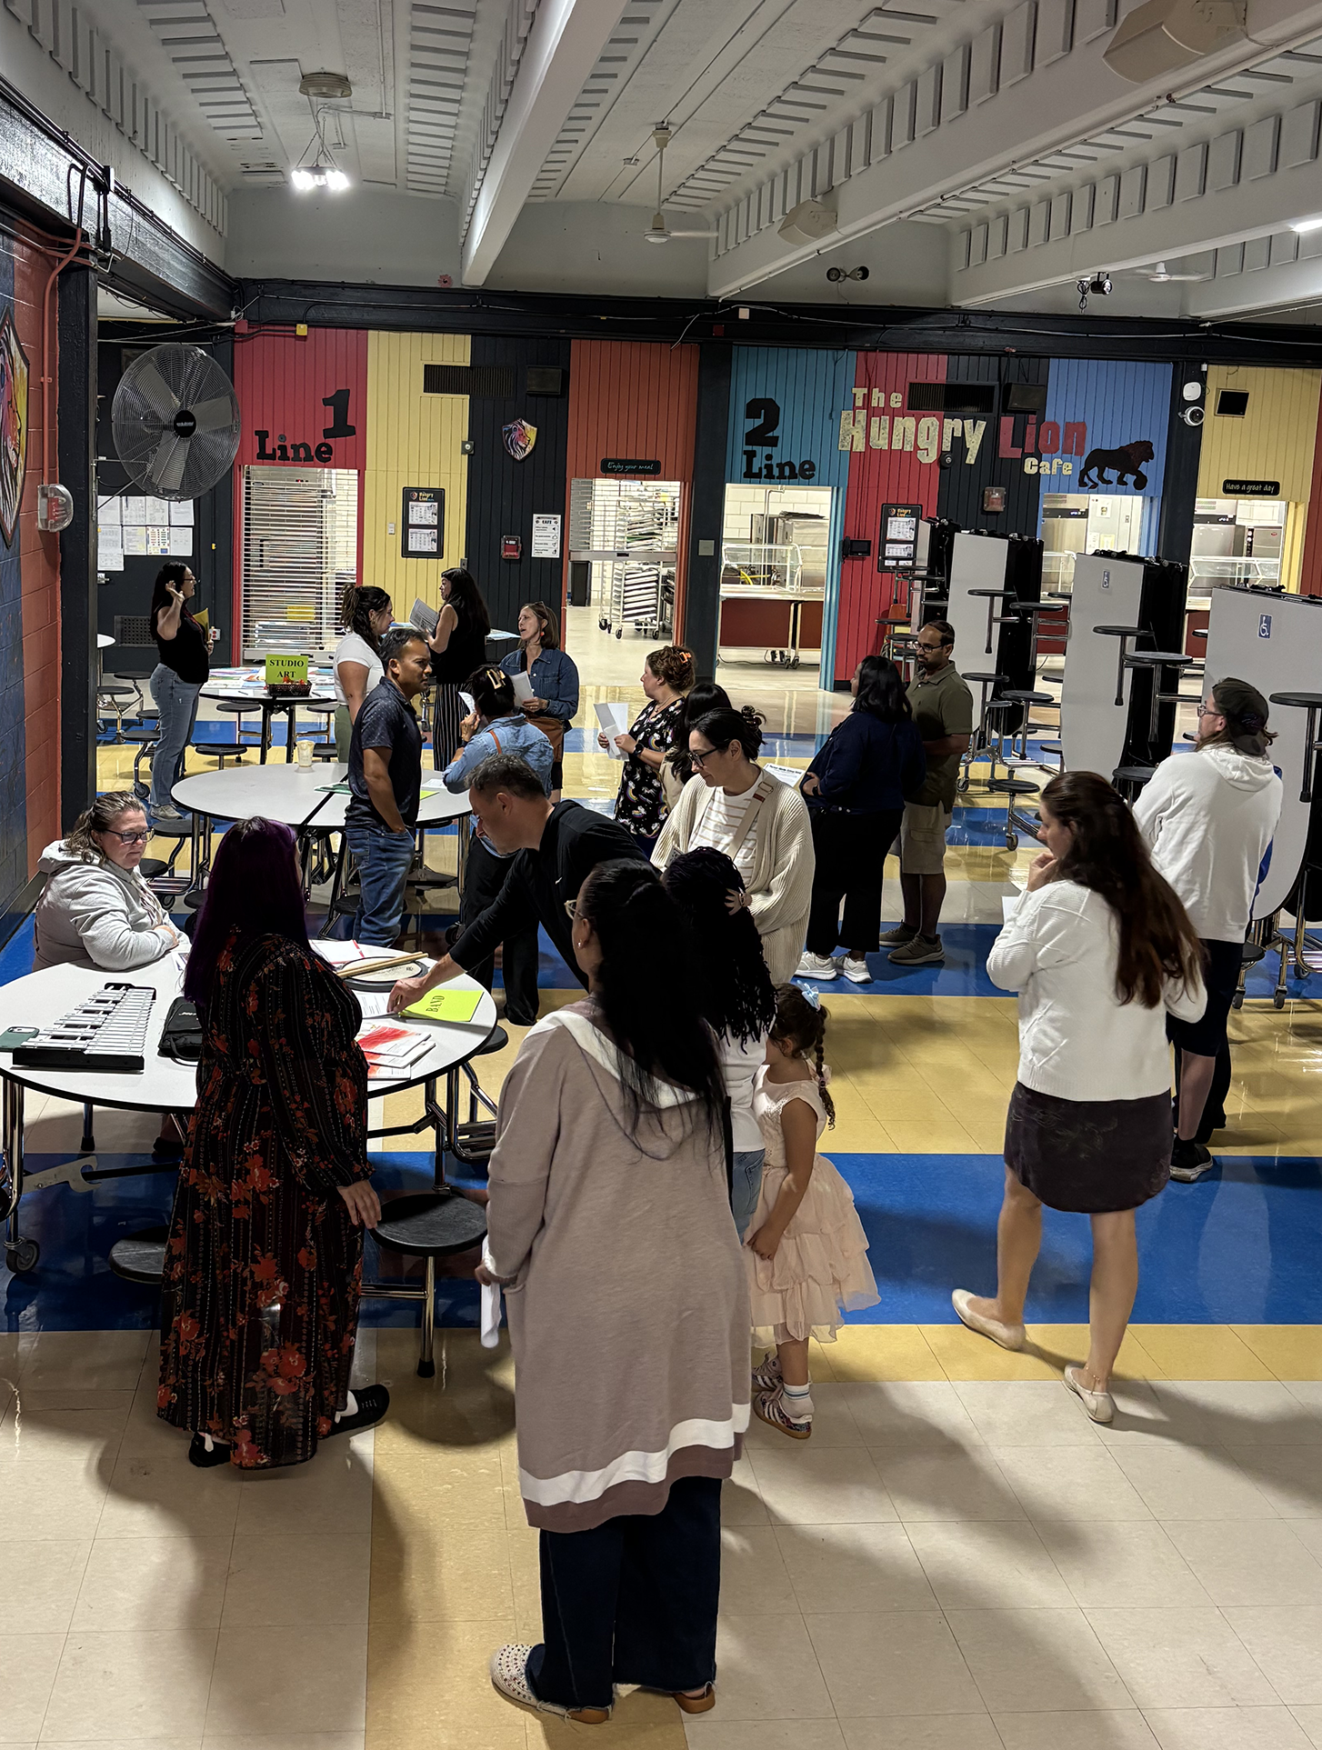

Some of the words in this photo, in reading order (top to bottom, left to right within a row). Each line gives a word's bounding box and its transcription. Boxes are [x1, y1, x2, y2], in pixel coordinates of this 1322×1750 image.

[852, 387, 902, 408] The
[254, 430, 333, 463] Line
[322, 388, 356, 439] 1
[745, 397, 780, 448] 2
[838, 409, 987, 465] Hungry
[999, 414, 1087, 459] Lion
[743, 449, 816, 480] Line
[1023, 457, 1073, 475] Cafe
[1225, 482, 1240, 490] Have
[1246, 484, 1262, 493] great
[1263, 484, 1275, 494] day
[269, 659, 304, 668] STUDIO
[277, 670, 296, 678] ART
[425, 995, 445, 1013] BAND
